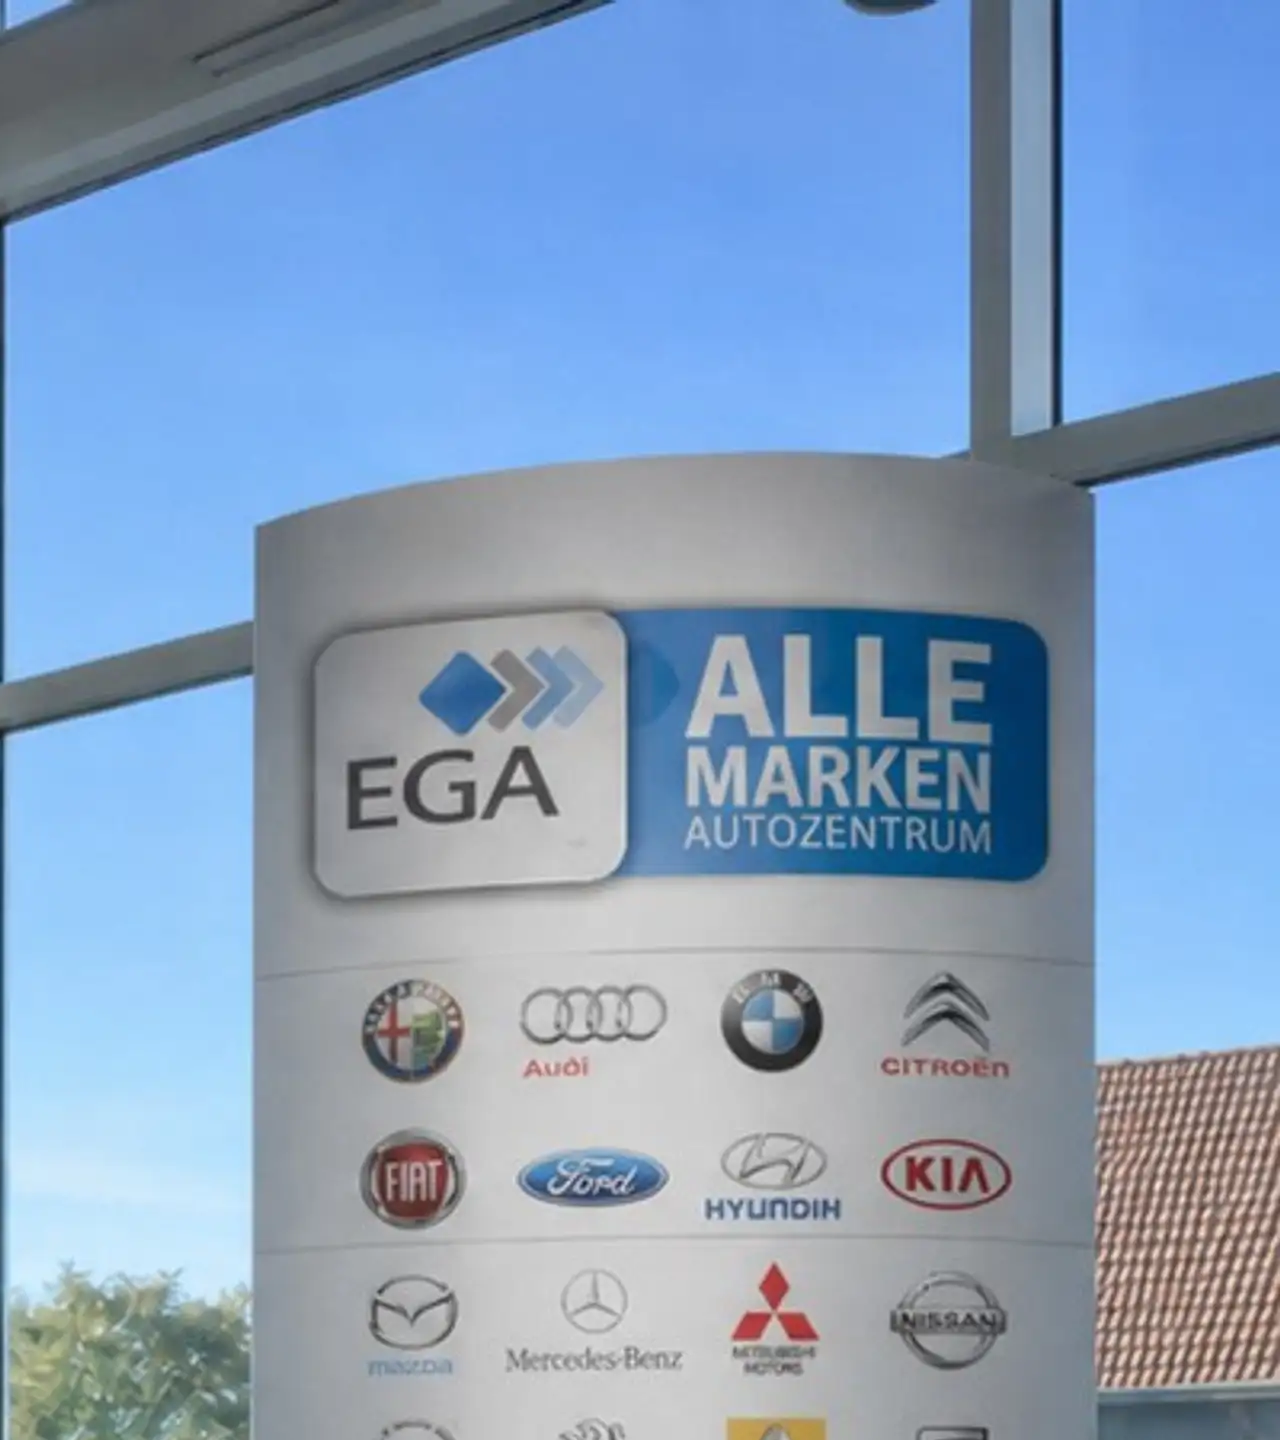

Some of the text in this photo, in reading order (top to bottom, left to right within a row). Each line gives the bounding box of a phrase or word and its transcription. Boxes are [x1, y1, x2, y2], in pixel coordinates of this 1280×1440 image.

[684, 634, 994, 745] ALLE
[346, 745, 560, 831] EGA
[686, 746, 992, 813] MARKEN
[684, 814, 993, 855] AUTOZENTRUM
[523, 1056, 589, 1078] Audi
[386, 1161, 443, 1202] FIAT
[546, 1157, 637, 1196] Ford
[906, 1156, 990, 1193] KIA
[505, 1346, 684, 1372] Mercedes-Benz
